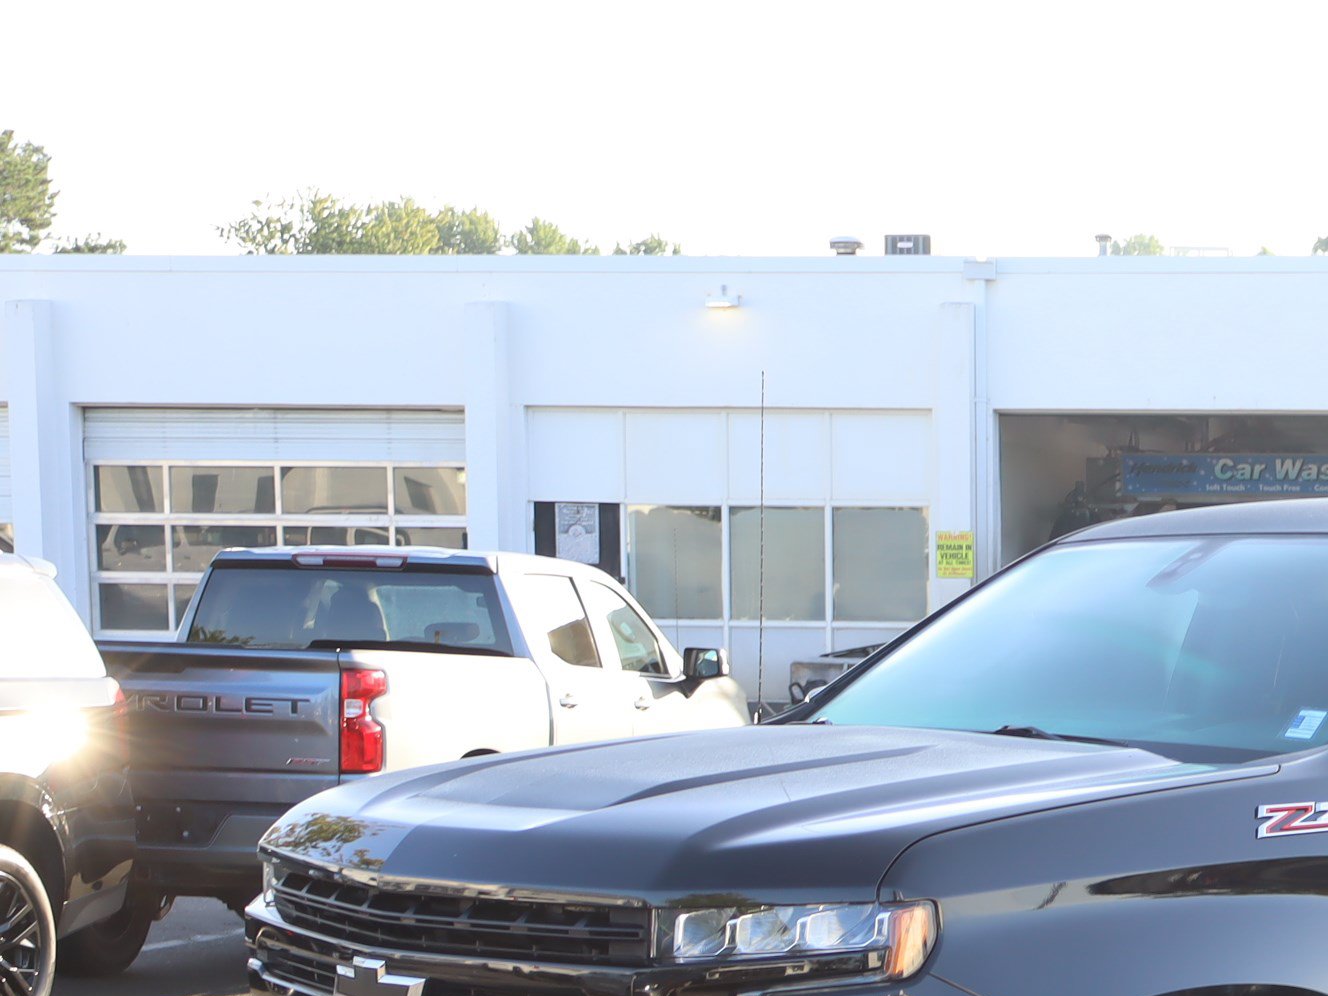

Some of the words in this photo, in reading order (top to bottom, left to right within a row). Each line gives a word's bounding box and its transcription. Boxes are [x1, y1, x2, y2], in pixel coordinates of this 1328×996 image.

[1214, 458, 1266, 481] Car
[1222, 484, 1246, 492] Touch
[1259, 484, 1282, 492] Touch
[940, 552, 969, 560] VEHICLE
